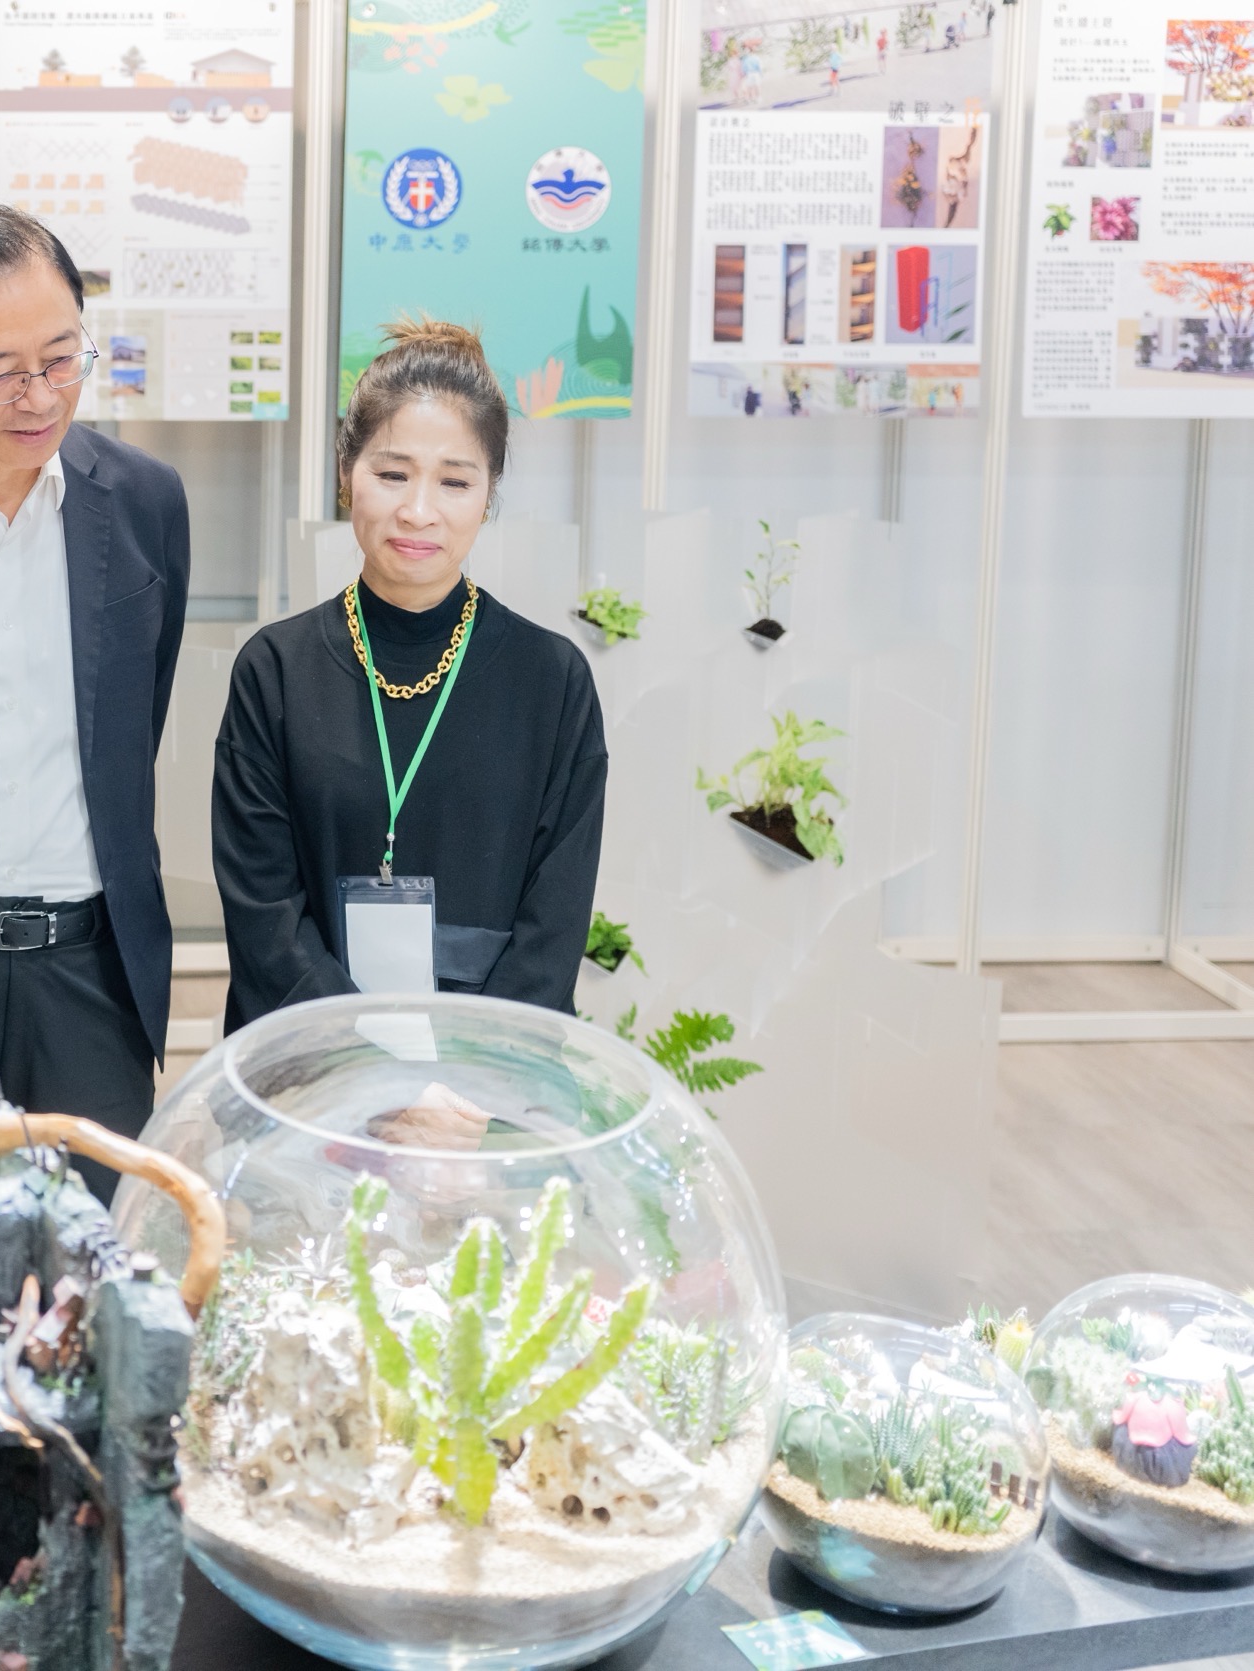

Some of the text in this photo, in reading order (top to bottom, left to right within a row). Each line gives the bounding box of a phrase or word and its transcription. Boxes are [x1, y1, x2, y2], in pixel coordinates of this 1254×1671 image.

[368, 232, 470, 254] 中原大學
[521, 236, 612, 253] 銘傳大學
